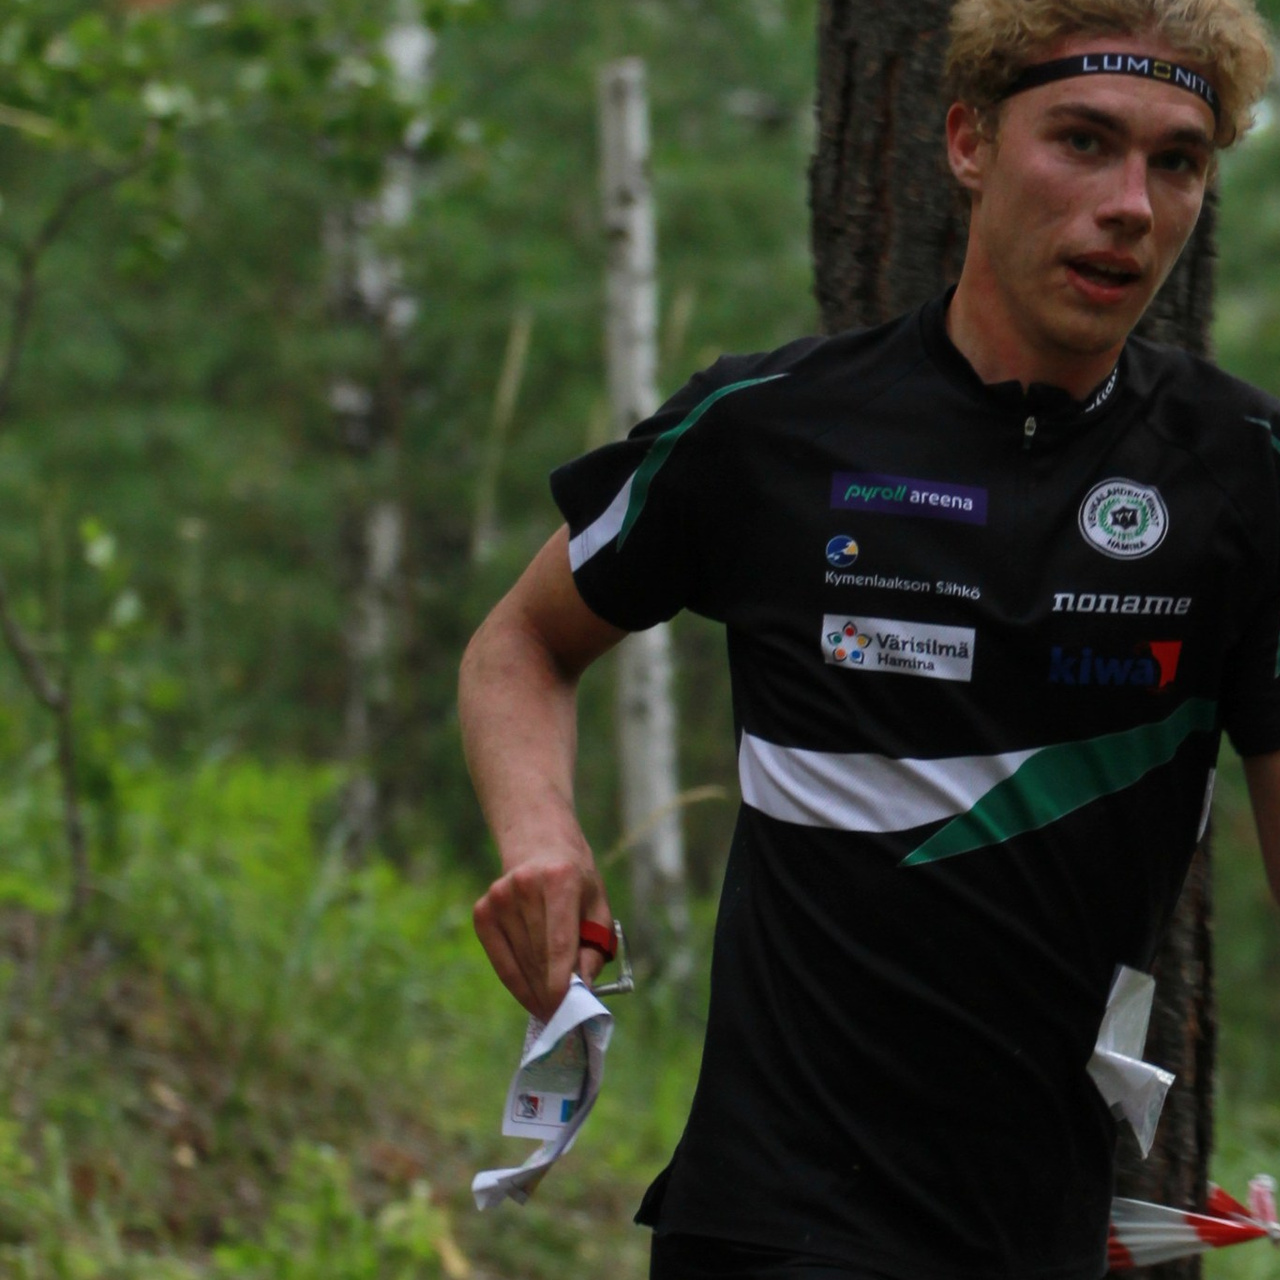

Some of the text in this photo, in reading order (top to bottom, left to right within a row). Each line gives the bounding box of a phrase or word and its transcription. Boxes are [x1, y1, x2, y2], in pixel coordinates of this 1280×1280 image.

[1083, 55, 1214, 103] LUMONITE
[843, 483, 973, 511] pyroll areena
[1106, 538, 1147, 552] HAMINA
[825, 570, 981, 600] Kymenlaakson Sähkö
[1052, 592, 1192, 615] noname
[876, 632, 969, 659] Värisilmä
[877, 654, 935, 670] Hamina
[1049, 644, 1154, 685] kiwa
